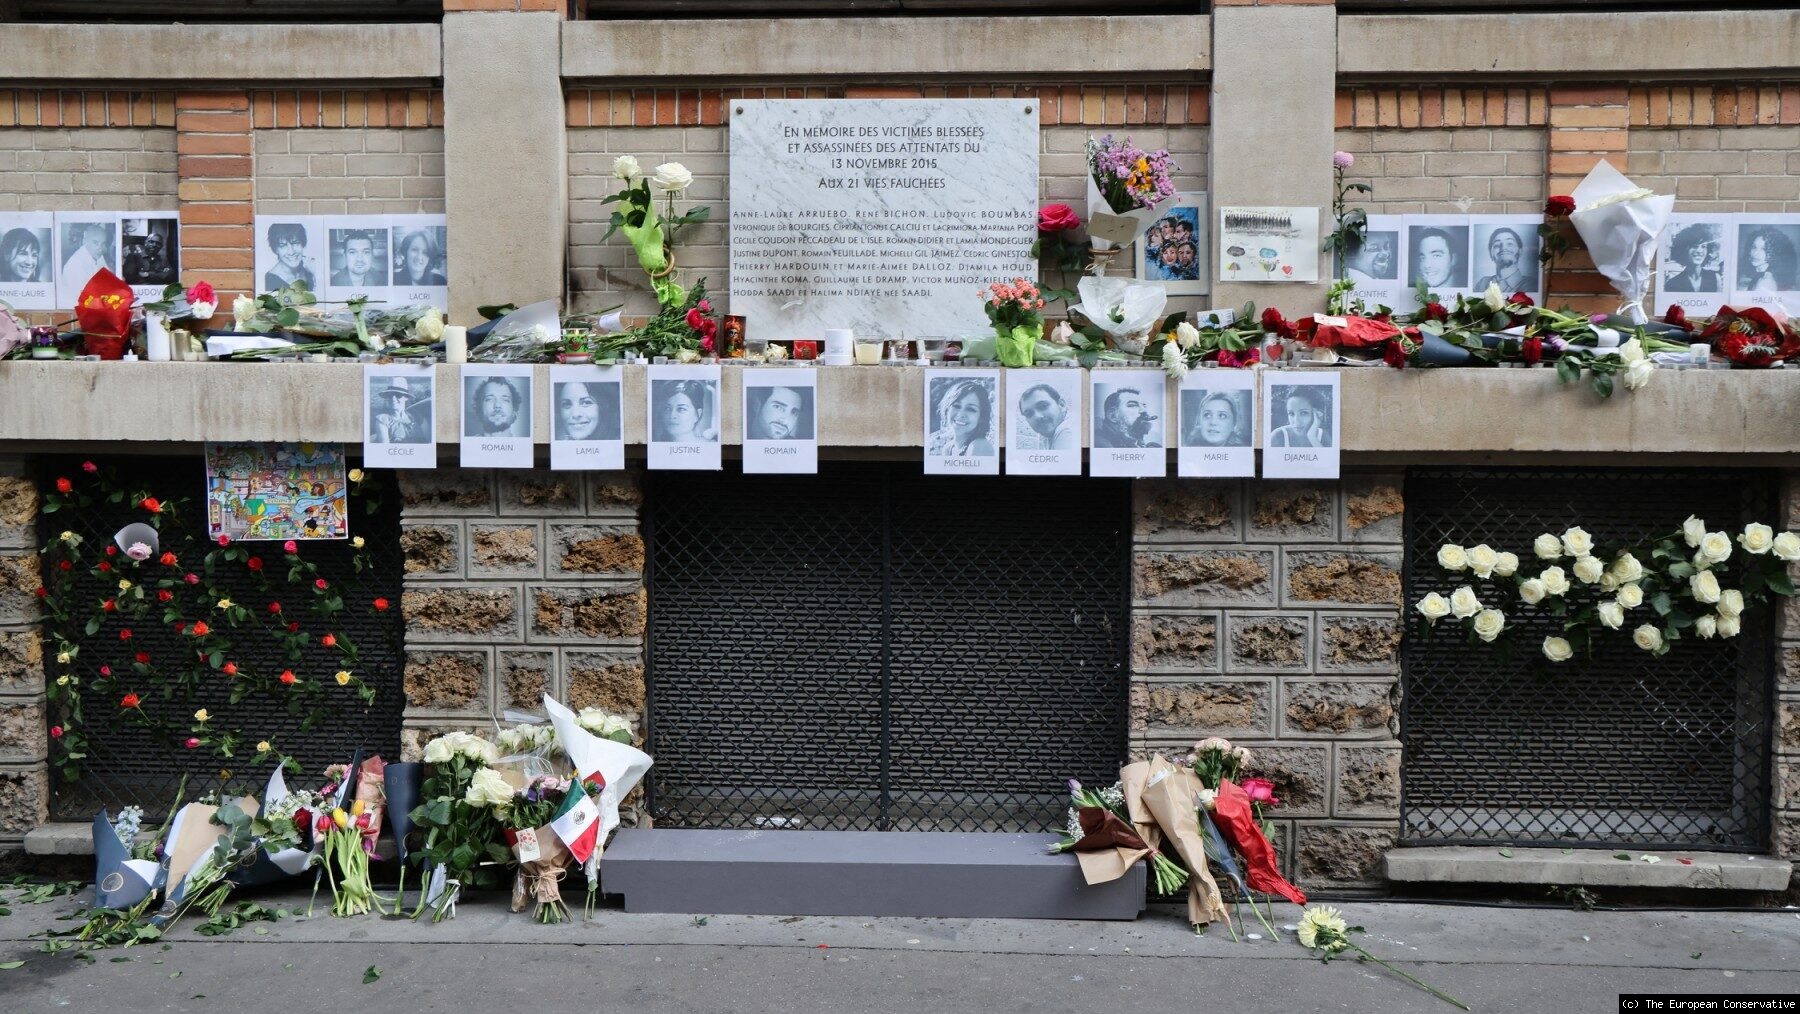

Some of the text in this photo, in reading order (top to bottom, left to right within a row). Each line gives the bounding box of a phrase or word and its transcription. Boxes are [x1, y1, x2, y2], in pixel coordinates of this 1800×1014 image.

[784, 126, 799, 137] EN
[859, 126, 878, 137] DES
[881, 126, 933, 137] VICTIMES
[788, 142, 800, 153] ET
[876, 142, 896, 153] DES
[899, 142, 960, 153] ATTENTATS
[964, 142, 980, 153] DU
[831, 158, 937, 169] 13 NOVEMBRE 2015
[818, 178, 843, 189] AUX
[847, 178, 859, 189] 21
[864, 178, 887, 189] VIES
[733, 210, 793, 218] ANNE-LAURE
[934, 210, 976, 218] LUDOVIC
[734, 250, 760, 258] JUSTINE
[801, 250, 831, 258] ROMAIN
[880, 250, 913, 258] MICHELLI
[914, 250, 928, 258] GIL
[959, 263, 998, 271] DJAMILA
[133, 288, 162, 296] LUDOV
[734, 289, 763, 297] HODDA
[767, 289, 795, 297] SAADI
[811, 289, 843, 297] HALIMA
[847, 289, 881, 297] NDIAYE
[1677, 299, 1709, 307] HODDA
[388, 446, 415, 456] CÉCILE
[481, 444, 514, 452] ROMAIN
[576, 447, 600, 455] LAMIA
[669, 446, 701, 455] JUSTINE
[764, 447, 797, 455] ROMAIN
[1029, 454, 1059, 463] CÉDRIC
[1112, 453, 1145, 461] THIERRY
[1203, 453, 1229, 461] MARIE
[1284, 453, 1319, 462] DJAMILA
[944, 459, 980, 467] MICHELLI
